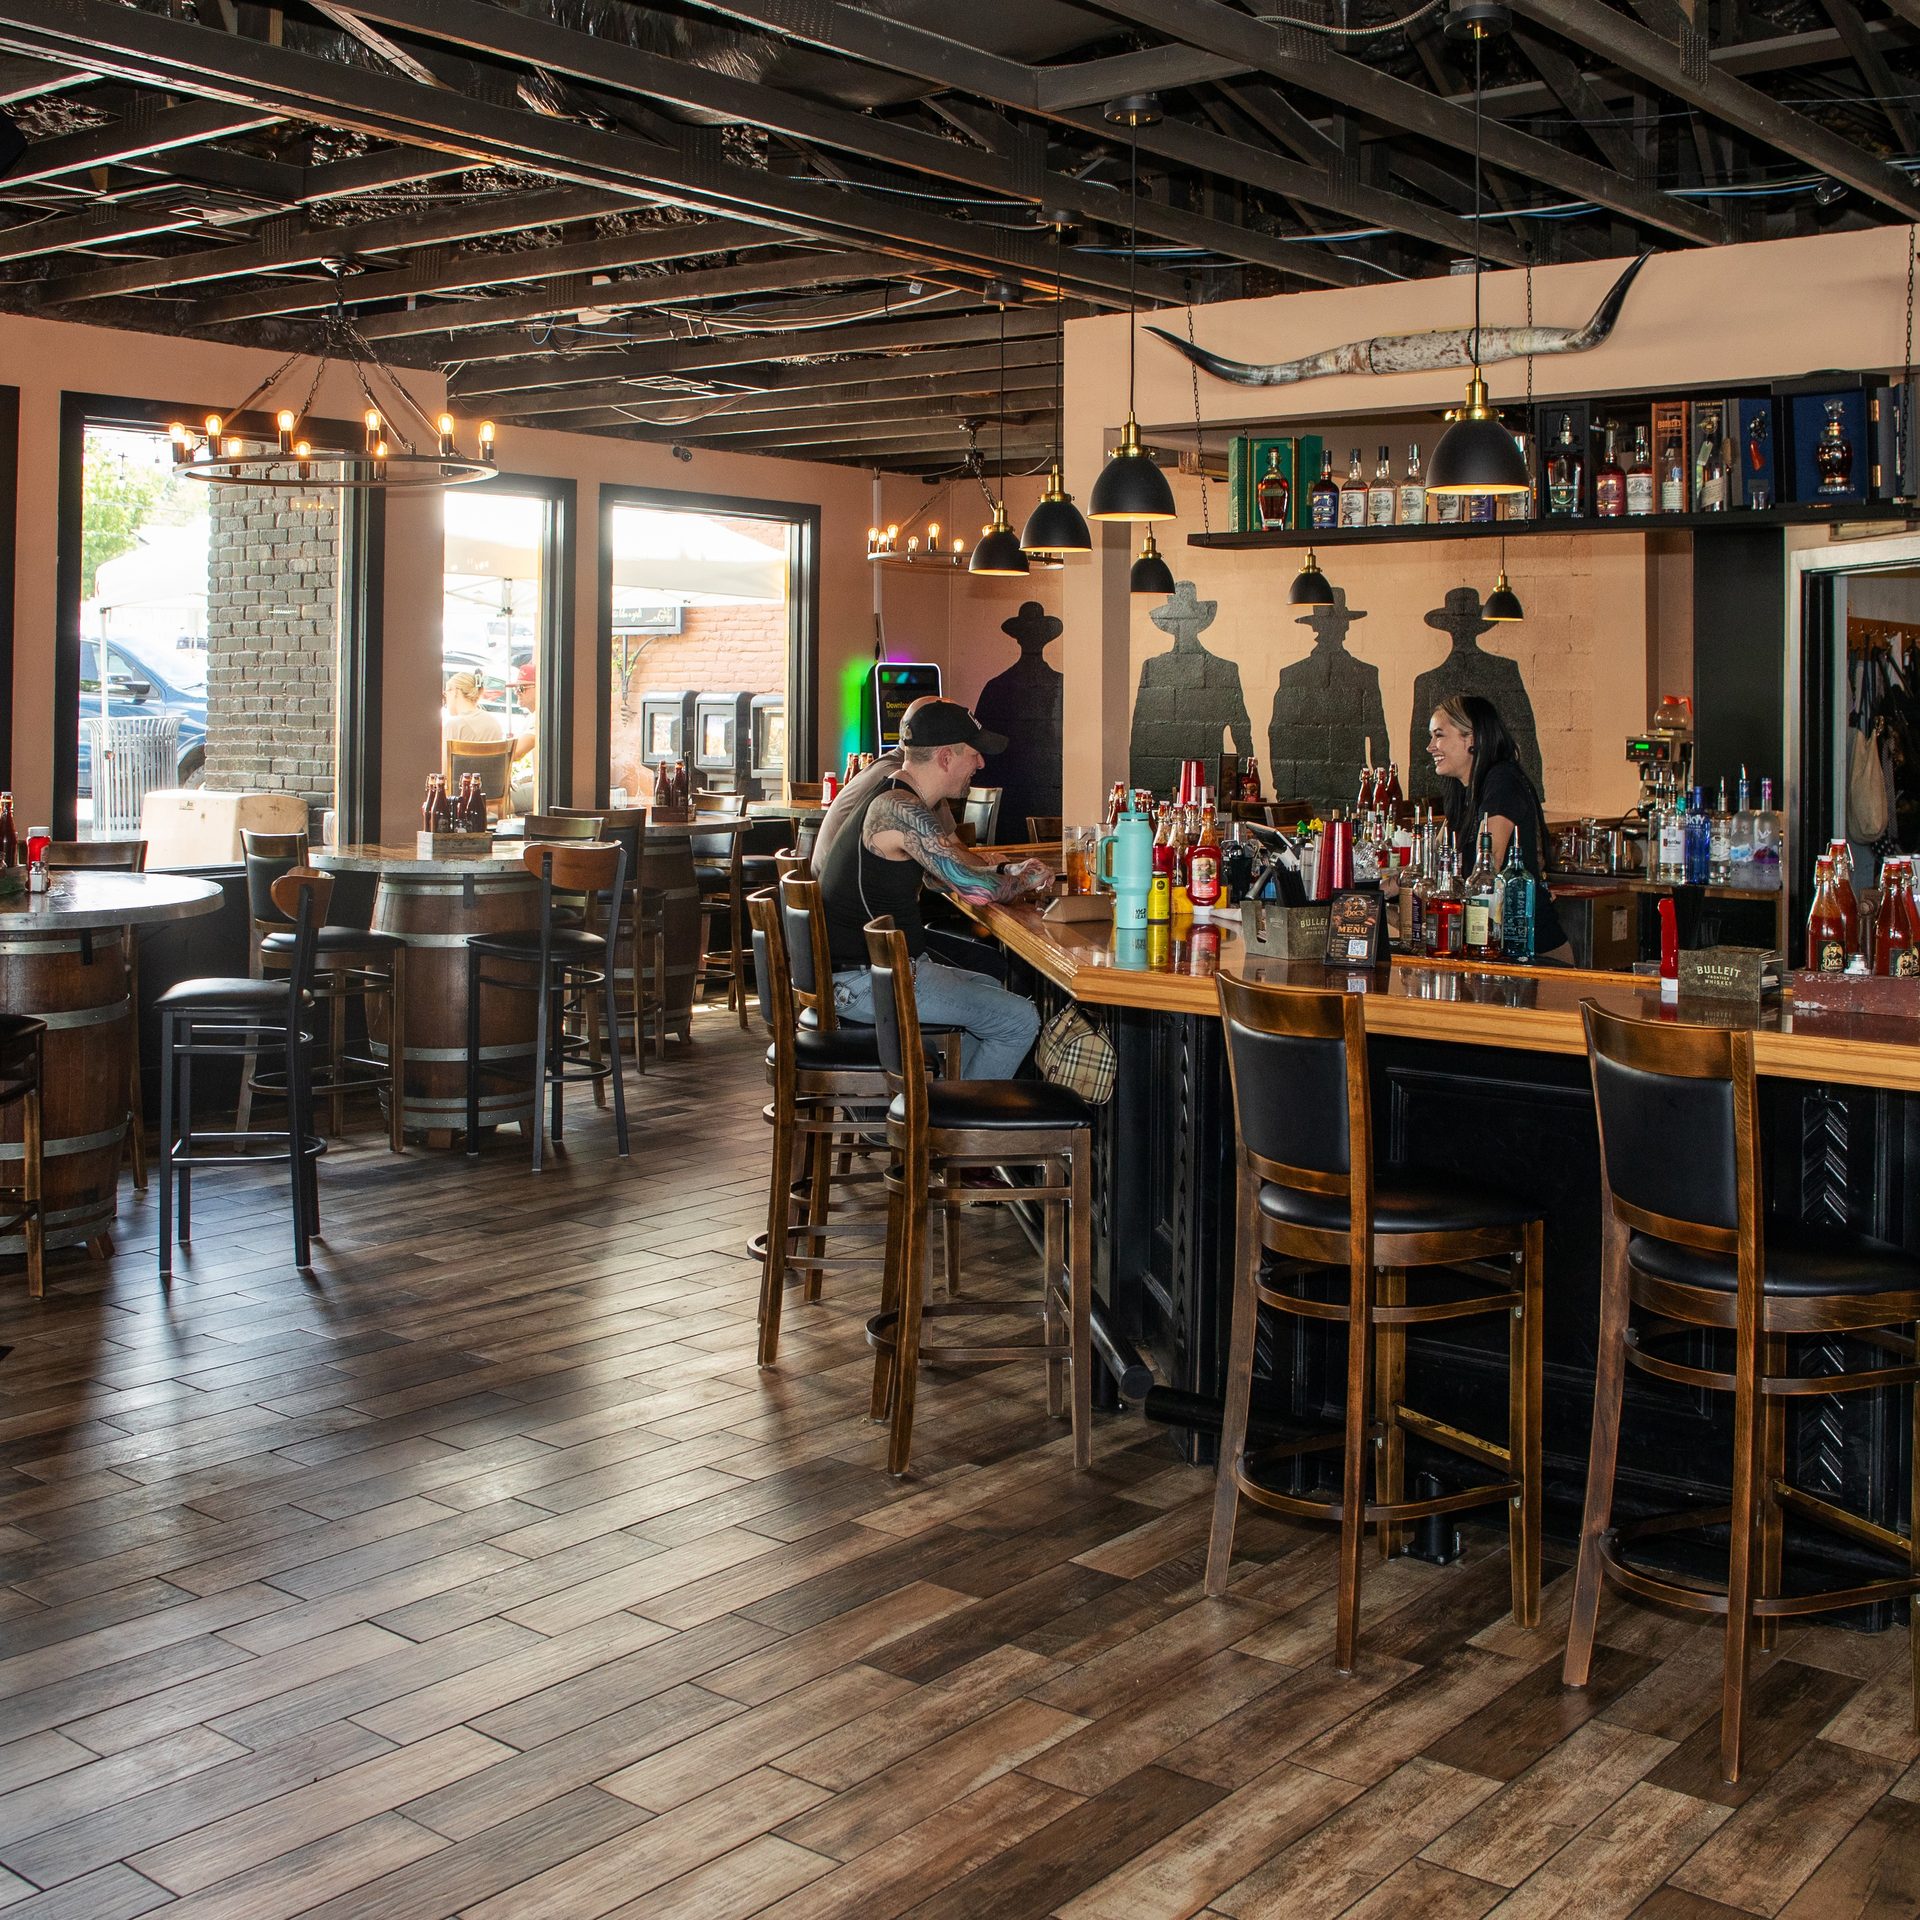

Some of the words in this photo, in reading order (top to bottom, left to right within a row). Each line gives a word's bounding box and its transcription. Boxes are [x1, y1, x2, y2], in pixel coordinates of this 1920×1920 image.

[1685, 813, 1705, 825] SKYY
[1300, 918, 1328, 928] BULLEI
[1337, 925, 1368, 934] MENU
[1696, 965, 1741, 978] BULLEIT
